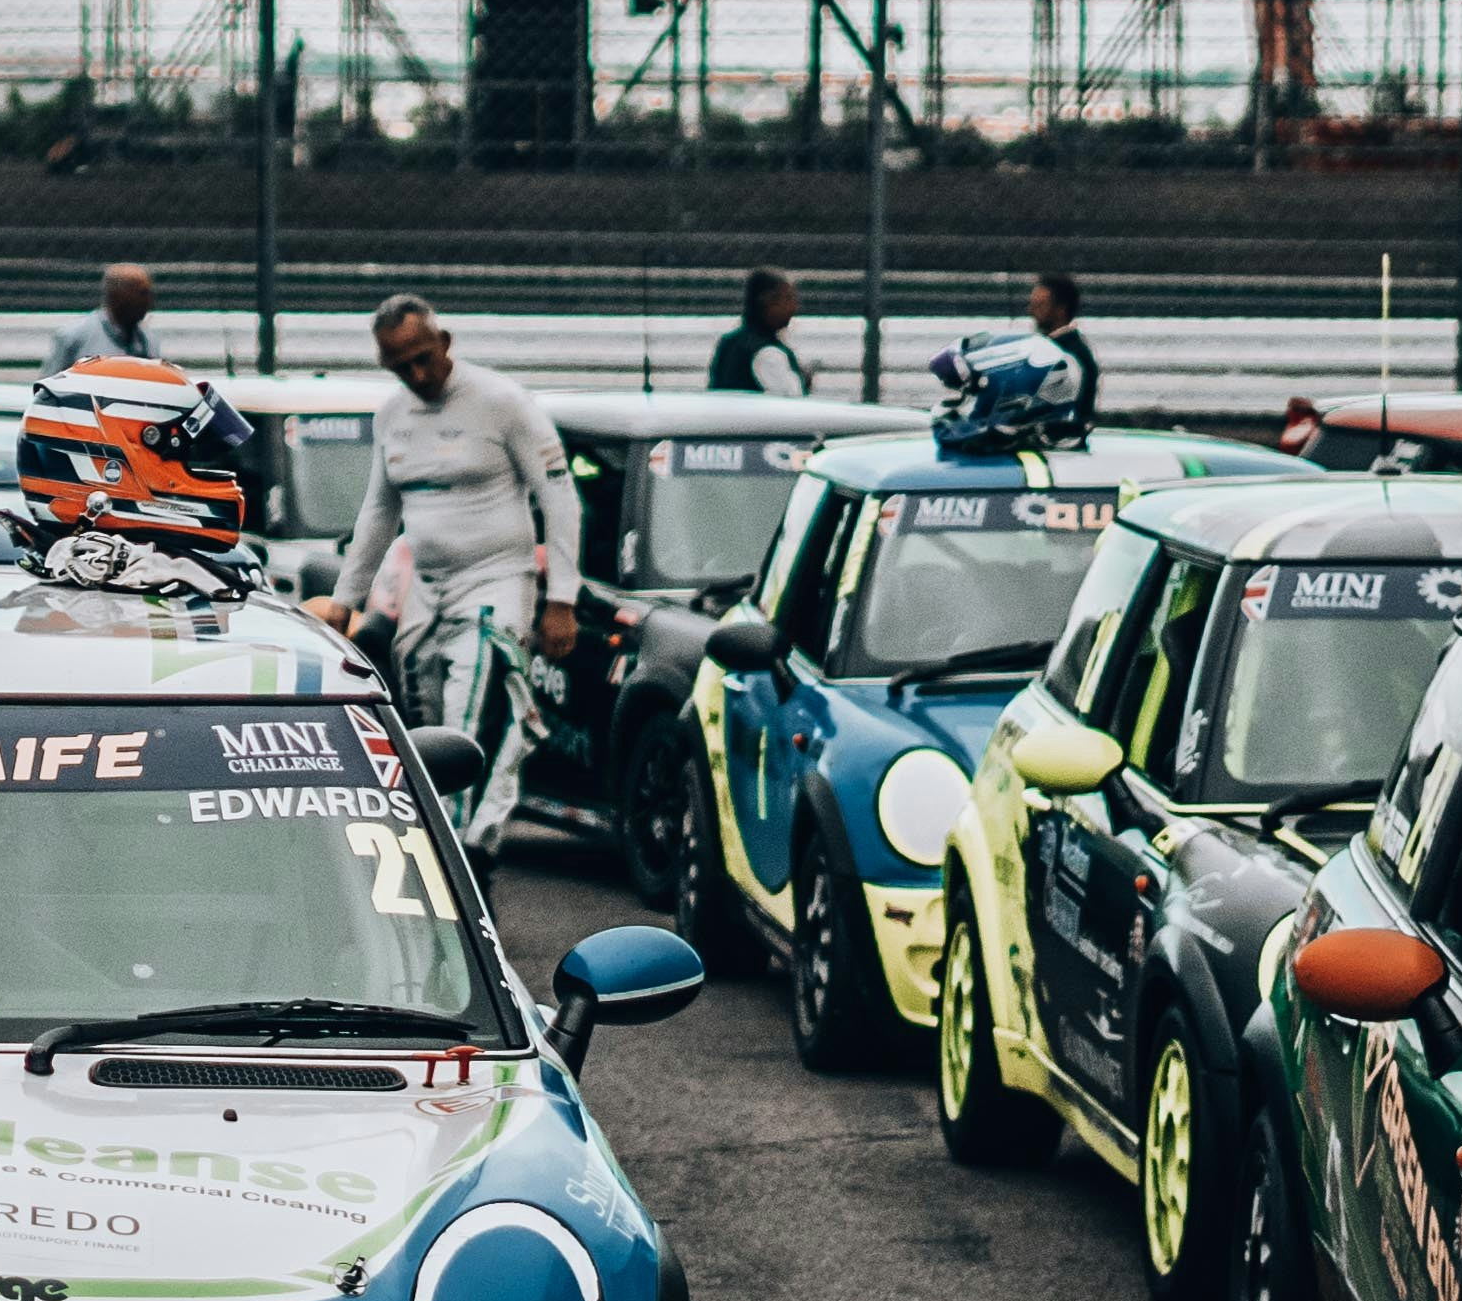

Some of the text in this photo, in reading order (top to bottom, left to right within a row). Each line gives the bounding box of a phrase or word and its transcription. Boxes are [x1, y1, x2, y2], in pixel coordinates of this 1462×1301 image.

[1292, 572, 1386, 599] MINI
[211, 720, 338, 757] MINI
[227, 753, 344, 774] CHALLENGE
[189, 787, 418, 824] EDWARDS
[345, 822, 458, 922] 21
[27, 1166, 48, 1178] &
[57, 1170, 232, 1199] Commercial
[241, 1189, 368, 1225] Cleaning
[84, 1240, 141, 1254] FINANCE
